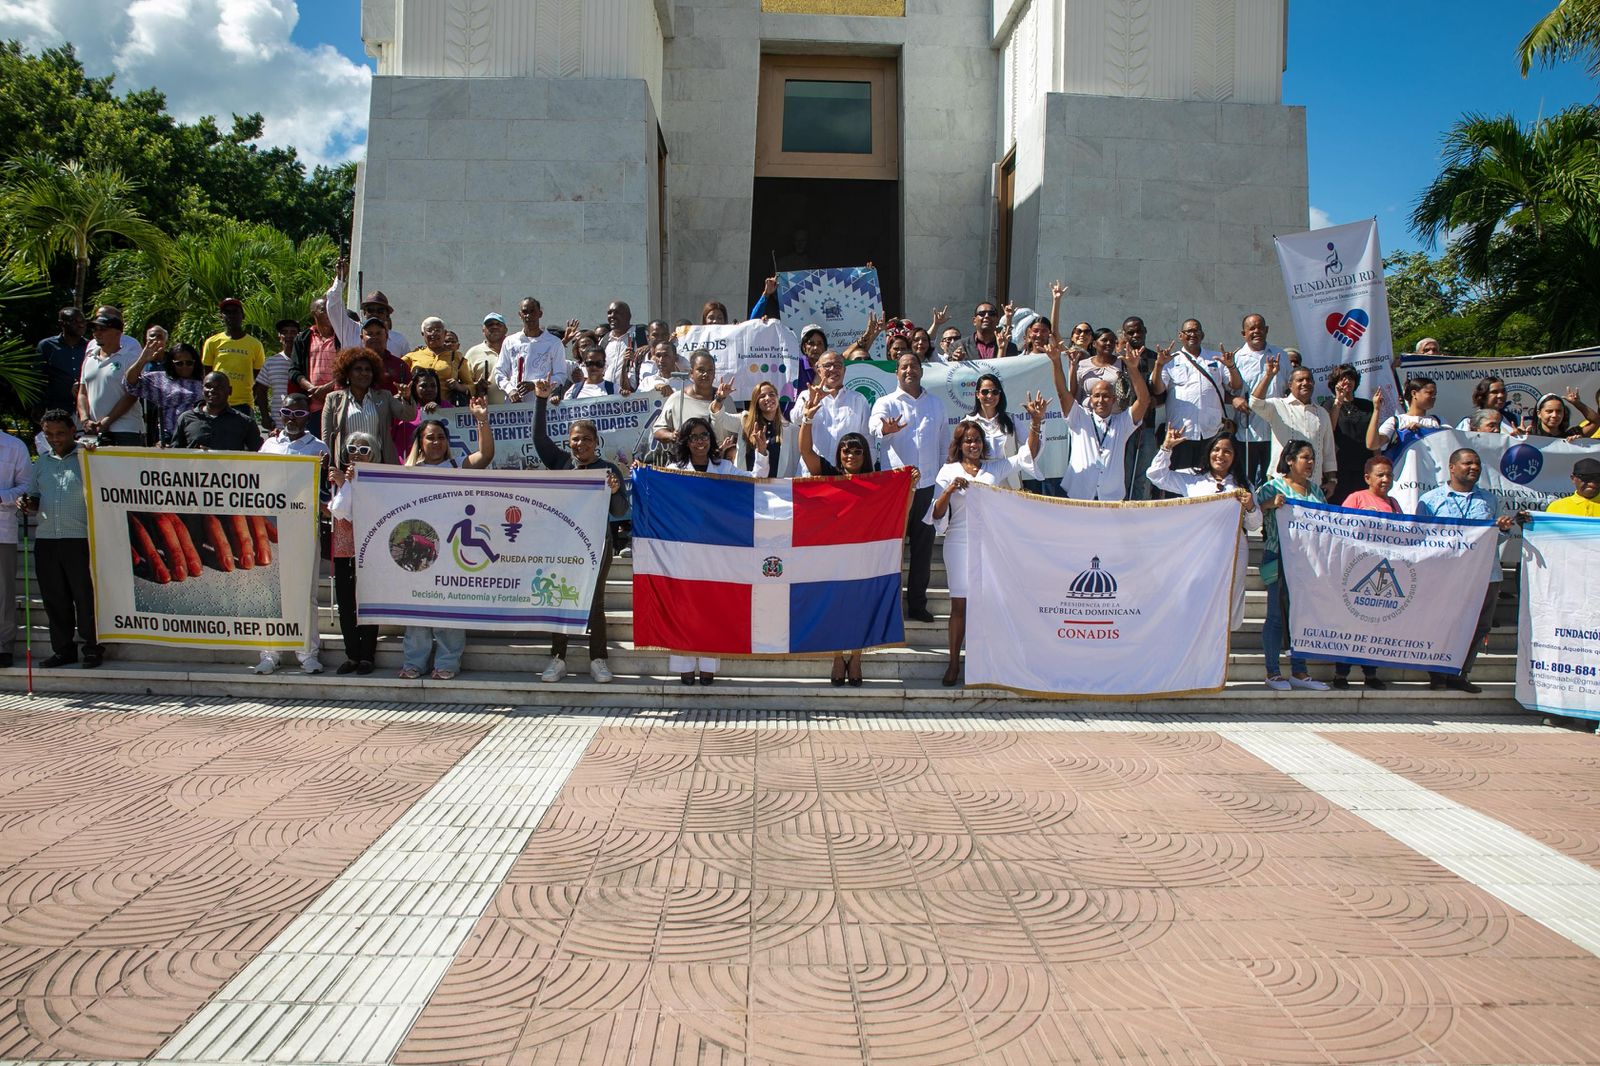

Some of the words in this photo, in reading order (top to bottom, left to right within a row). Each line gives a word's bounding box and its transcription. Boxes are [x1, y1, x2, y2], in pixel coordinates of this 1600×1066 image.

[1294, 274, 1357, 294] FUNDAPEDI
[1445, 370, 1489, 381] DOMINICANA
[1491, 369, 1500, 377] DE
[1501, 366, 1541, 378] VETERANOS
[1542, 365, 1559, 376] CON
[457, 410, 524, 428] FUNACION
[560, 402, 620, 420] PERSONAS
[623, 399, 648, 414] CON
[140, 470, 260, 490] ORGANIZACION
[101, 487, 198, 507] DOMINICANA
[203, 491, 223, 508] DE
[229, 492, 286, 509] CIEGOS
[290, 501, 307, 511] INC.
[376, 502, 411, 528] DEPORTIVA
[419, 490, 463, 505] RECREATIVA
[464, 489, 474, 497] DE
[475, 490, 513, 500] PERSONAS
[515, 494, 530, 504] CON
[531, 499, 575, 528] DISCAPACIDAD
[1288, 520, 1364, 540] DISCAPACIDAD
[1303, 511, 1366, 527] ASOCIACION
[1369, 520, 1383, 529] DE
[1386, 523, 1437, 537] PERSONAS
[1440, 528, 1463, 538] CON
[500, 554, 526, 564] RUEDA
[527, 555, 543, 565] POR
[545, 555, 555, 565] TU
[556, 555, 585, 565] SUEÑO
[434, 575, 521, 590] FUNDEREPEDIF
[412, 590, 446, 601] Decisión,
[447, 591, 491, 602] Autonomía
[492, 594, 496, 604] y
[497, 593, 531, 604] Fortaleza
[1354, 596, 1398, 609] ASODIFIMO
[1039, 606, 1083, 616] REPÚBLICA
[1085, 608, 1141, 616] DOMINICANA
[114, 615, 159, 631] SANTO
[163, 618, 231, 637] DOMINGO,
[234, 621, 262, 636] REP.
[266, 622, 303, 637] DOM.
[1057, 628, 1120, 640] CONADIS
[1555, 628, 1600, 640] FUNDACIÓ
[1303, 628, 1351, 640] IGUALDAD
[1354, 633, 1368, 643] DE
[1371, 636, 1424, 649] DERECHOS
[1427, 641, 1434, 650] Y
[1293, 638, 1350, 651] UIPARACION
[1352, 644, 1366, 654] DE
[1368, 646, 1452, 662] OPORTUNIDADES
[1530, 660, 1549, 671] Tel.:
[1551, 662, 1596, 677] 809-684
